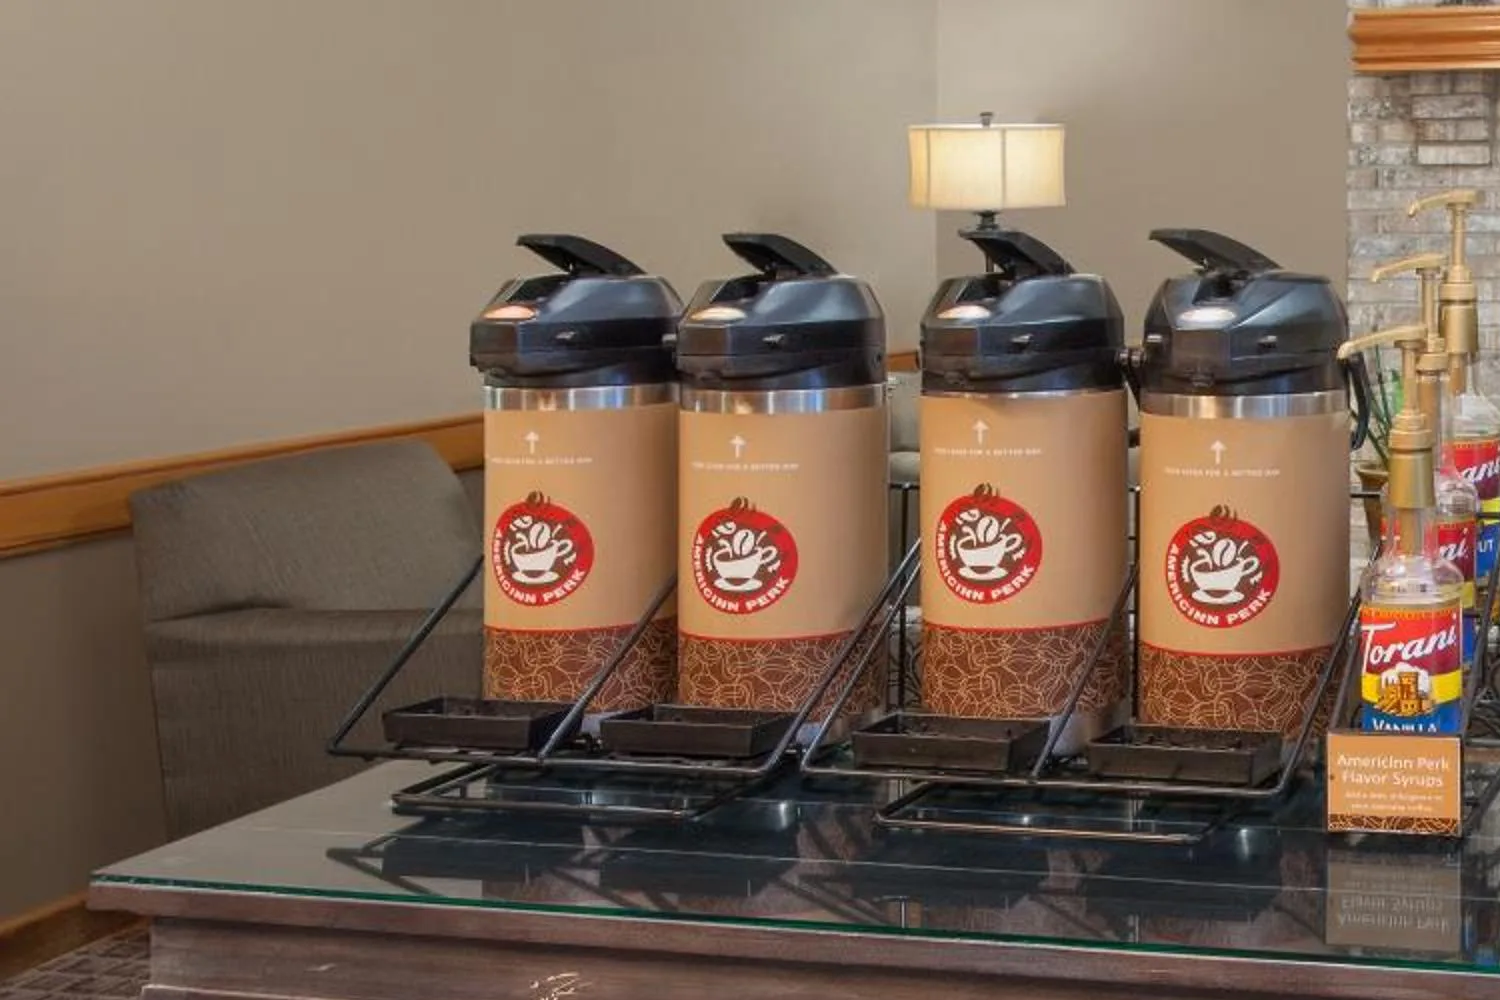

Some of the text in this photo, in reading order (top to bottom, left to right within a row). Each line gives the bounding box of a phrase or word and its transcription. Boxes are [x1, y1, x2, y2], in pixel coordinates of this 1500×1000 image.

[542, 569, 585, 602] PERK
[745, 577, 789, 610] PERK
[991, 565, 1034, 599] PERK
[1226, 588, 1272, 624] PERK
[1361, 613, 1457, 674] Torani
[1342, 769, 1444, 788] Flavor Syrups
[1417, 756, 1450, 772] Perk
